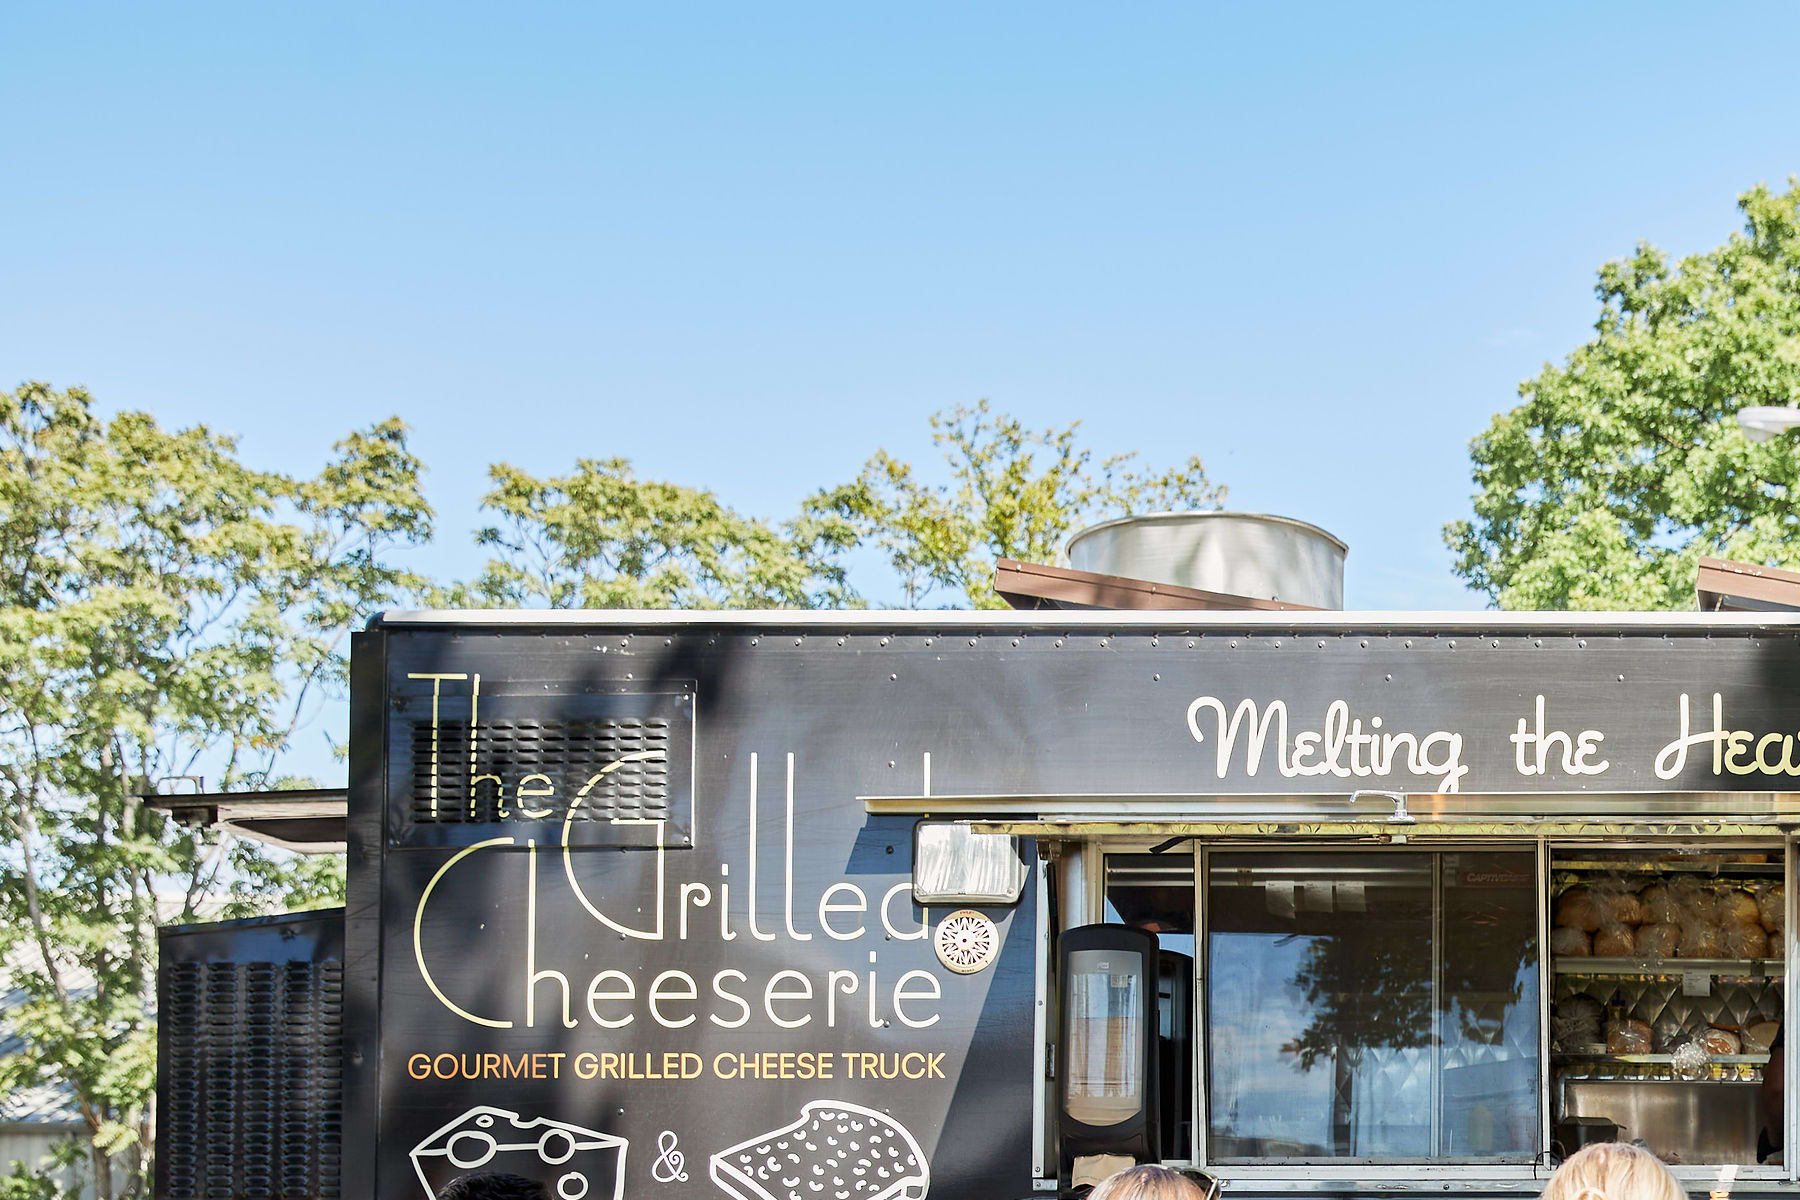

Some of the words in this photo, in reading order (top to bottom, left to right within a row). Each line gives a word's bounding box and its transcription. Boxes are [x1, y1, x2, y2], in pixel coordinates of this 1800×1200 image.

[407, 673, 555, 818] The
[1186, 696, 1468, 793] Melting
[1509, 694, 1609, 776] the
[561, 750, 930, 941] Grilled
[413, 837, 943, 1029] Cheeserie
[407, 1051, 566, 1079] GOURMET
[573, 1051, 702, 1079] GRILLED
[713, 1051, 833, 1079] CHEESE
[842, 1051, 946, 1079] TRUCK
